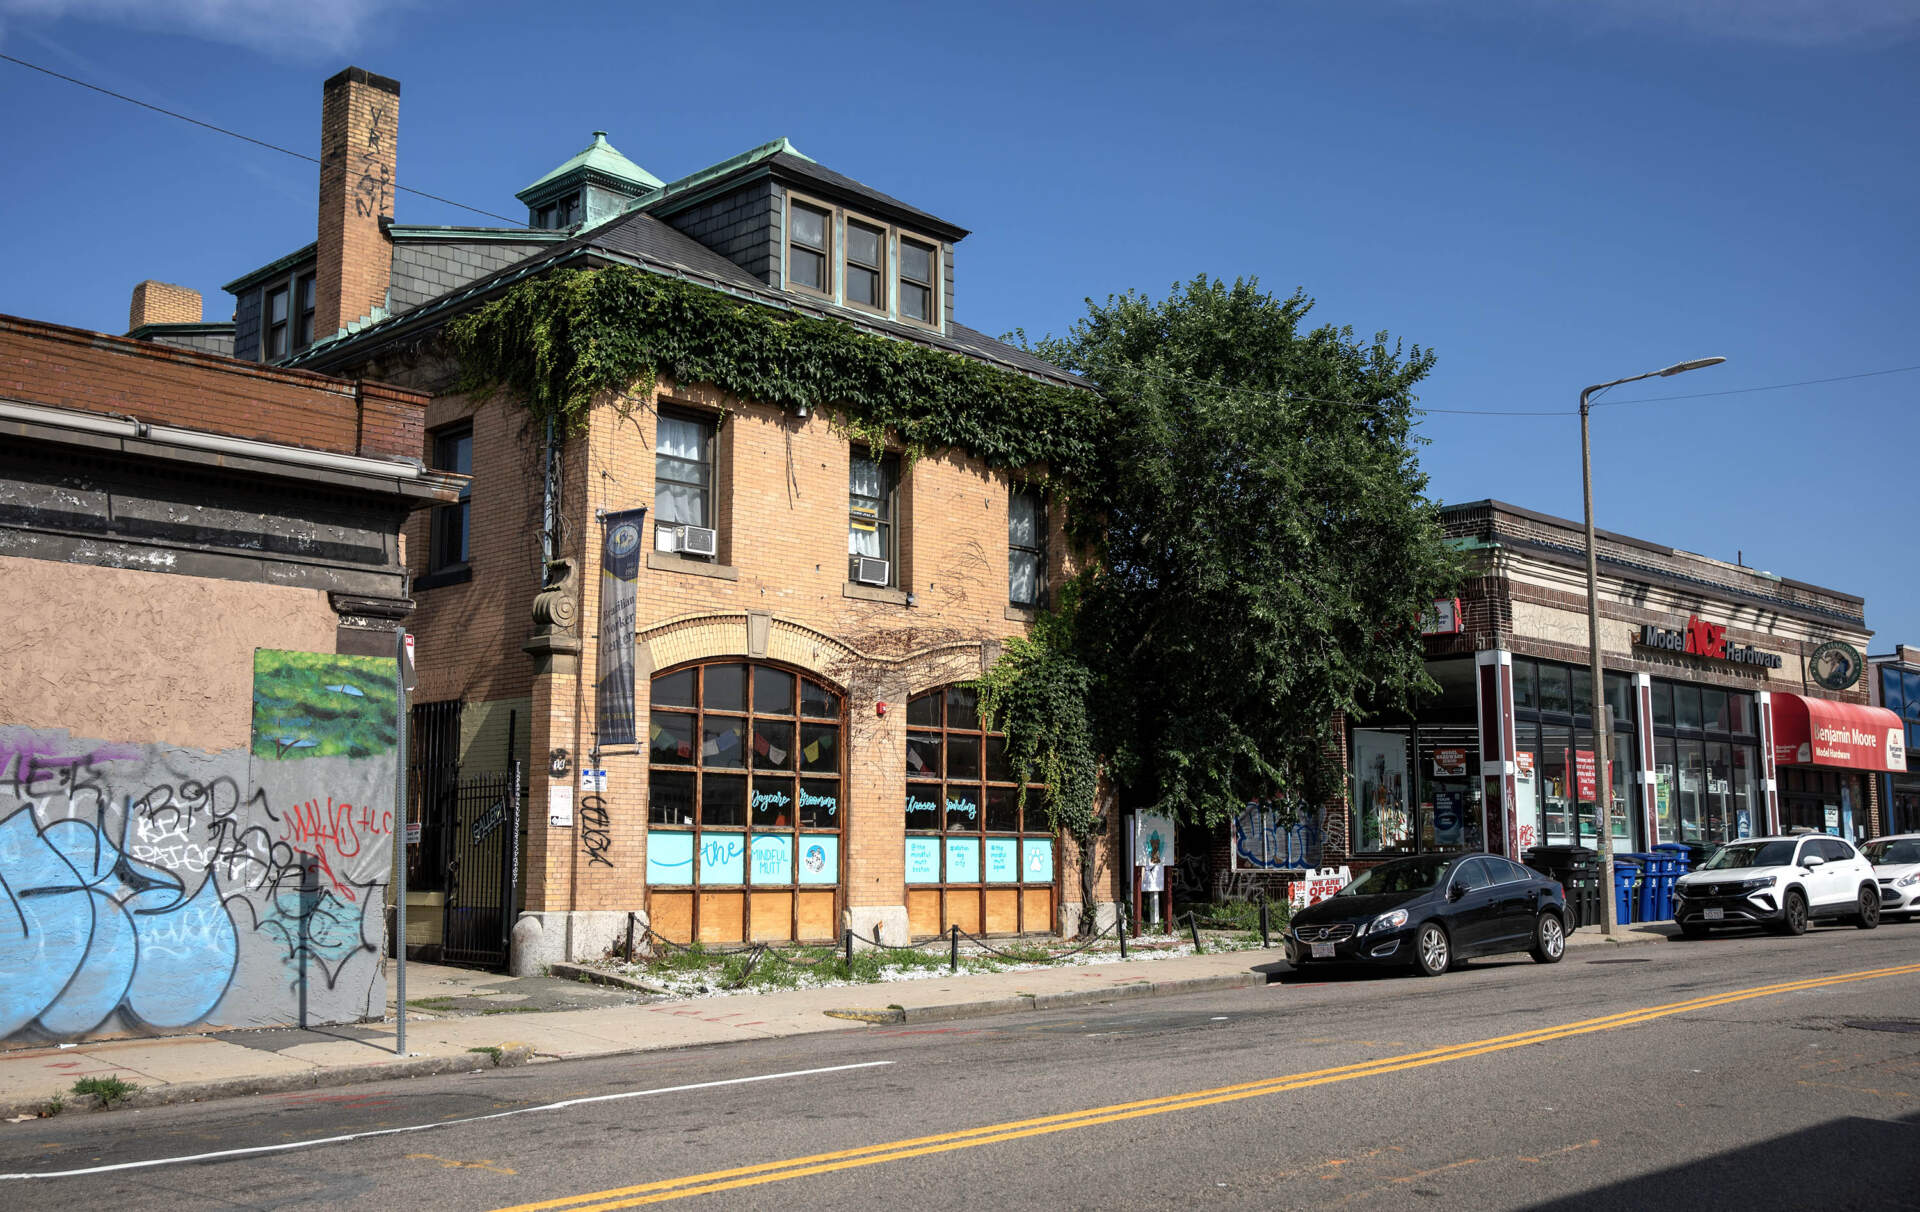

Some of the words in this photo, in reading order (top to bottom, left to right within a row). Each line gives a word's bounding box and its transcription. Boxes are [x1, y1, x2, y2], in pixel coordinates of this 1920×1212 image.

[603, 595, 635, 621] Brazilian
[603, 612, 635, 636] Worker
[602, 631, 634, 657] Center
[1641, 624, 1686, 652] Model
[1684, 614, 1727, 660] ACE
[1726, 639, 1783, 669] Hardware
[1814, 723, 1851, 746] Benjamin
[1851, 728, 1877, 748] Moore
[1815, 746, 1830, 758] Model
[1829, 749, 1851, 760] Hardware
[751, 788, 791, 812] Daycare
[702, 840, 742, 867] the
[751, 849, 788, 862] MINDFUL
[759, 861, 780, 874] MUTT
[1309, 885, 1342, 896] OPEN
